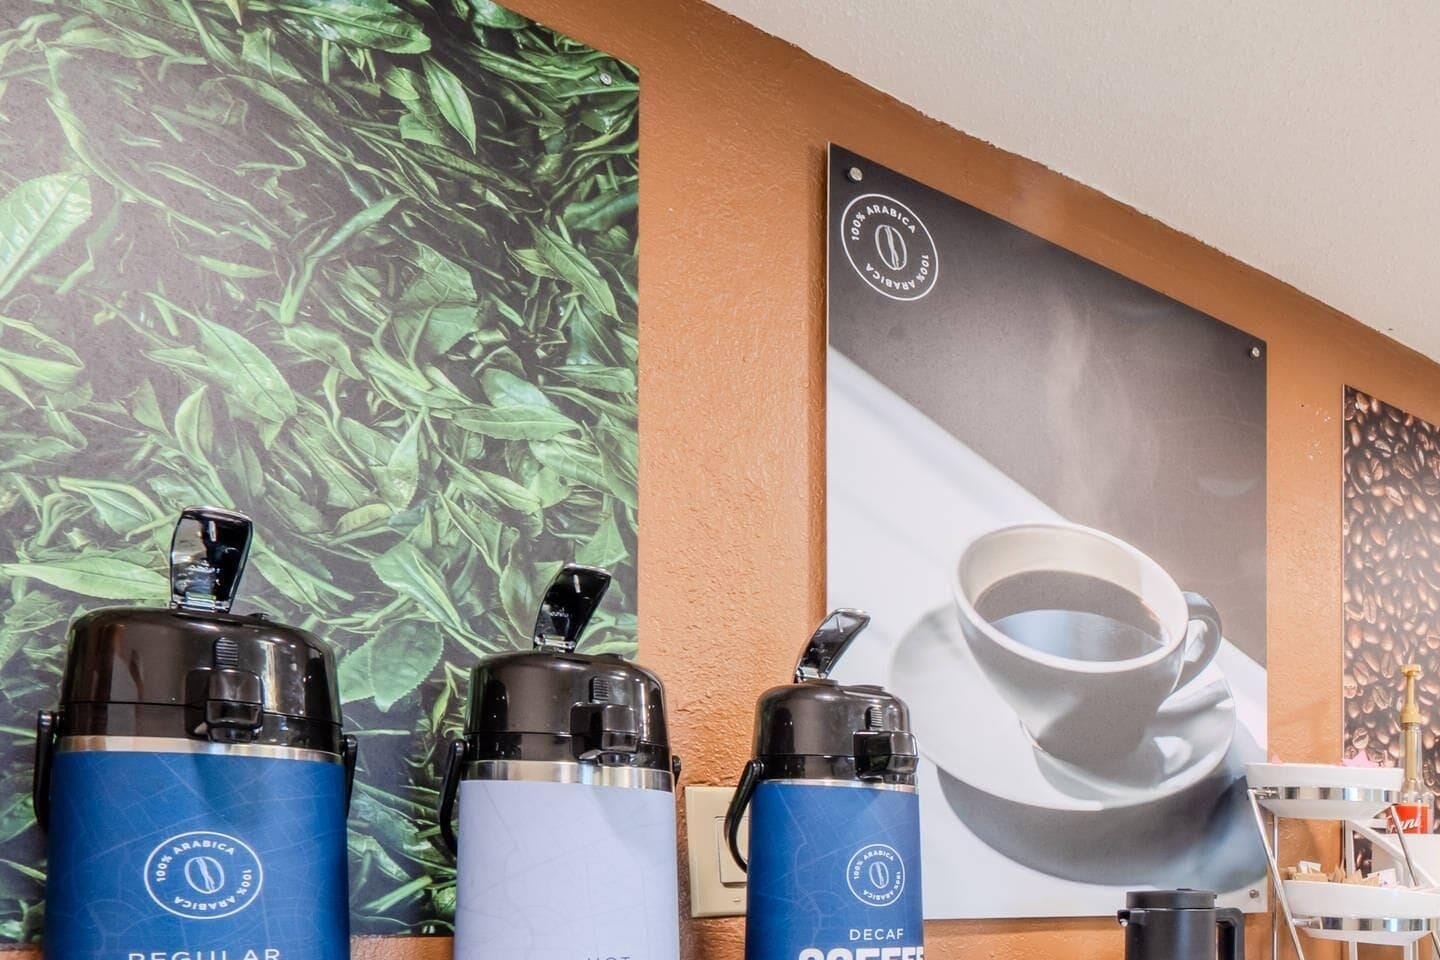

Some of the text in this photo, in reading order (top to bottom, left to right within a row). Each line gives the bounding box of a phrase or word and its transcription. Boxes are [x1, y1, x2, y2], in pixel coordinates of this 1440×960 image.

[850, 204, 917, 241] 100% ARABICA
[865, 254, 930, 291] 100% ARABICA
[156, 840, 235, 882] 100% ARABICA
[863, 850, 895, 861] ARABICA
[174, 869, 253, 911] 100% ARABICA
[849, 928, 905, 941] DECAF
